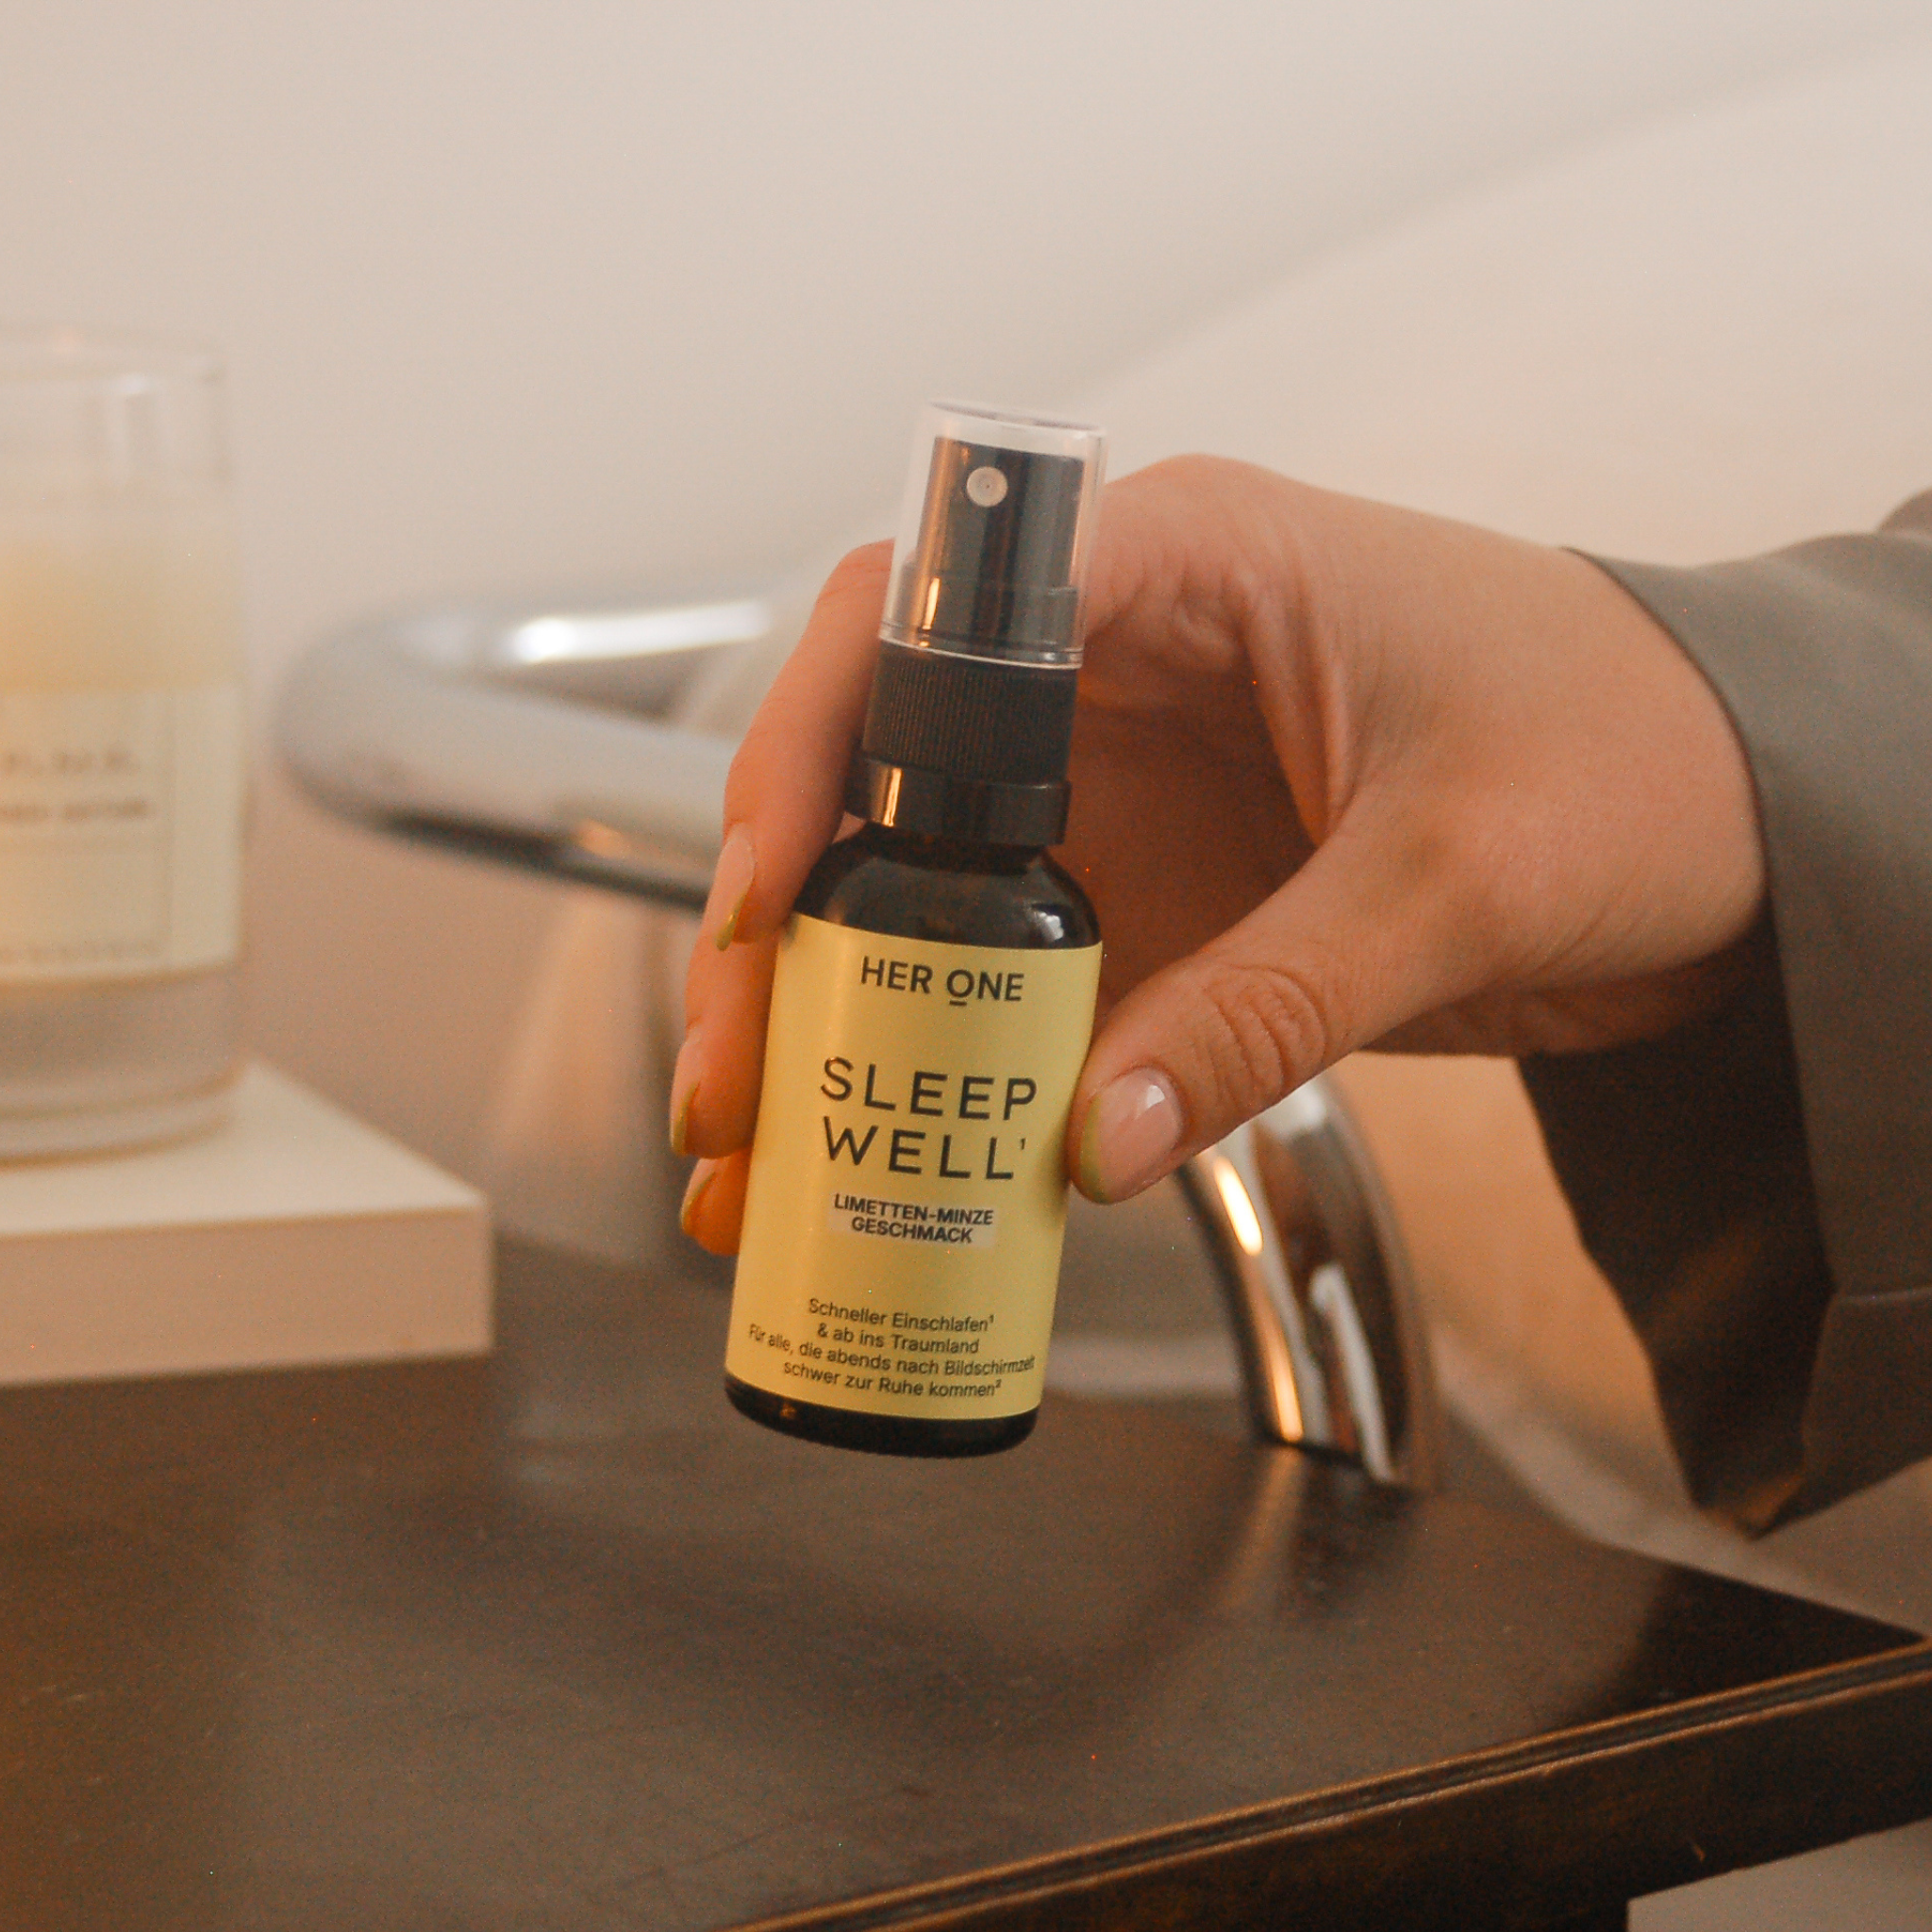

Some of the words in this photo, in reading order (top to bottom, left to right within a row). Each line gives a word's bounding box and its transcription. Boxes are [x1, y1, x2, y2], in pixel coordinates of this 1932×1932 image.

[860, 956, 933, 994] HER
[946, 969, 1024, 1007] ONE
[820, 1056, 1037, 1121] SLEEP
[834, 1193, 993, 1225] LIMETTEN-MINZE
[851, 1216, 974, 1244] GESCHMACK
[808, 1298, 887, 1327] Schneller
[817, 1323, 828, 1338] &
[834, 1324, 855, 1343] ab
[859, 1329, 884, 1348] ins
[892, 1333, 980, 1354] Traumland
[799, 1341, 824, 1359] die
[827, 1346, 891, 1370] abends
[897, 1356, 940, 1375] nach
[784, 1360, 840, 1385] schwer
[845, 1374, 873, 1391] zur
[878, 1379, 924, 1396] Ruhe
